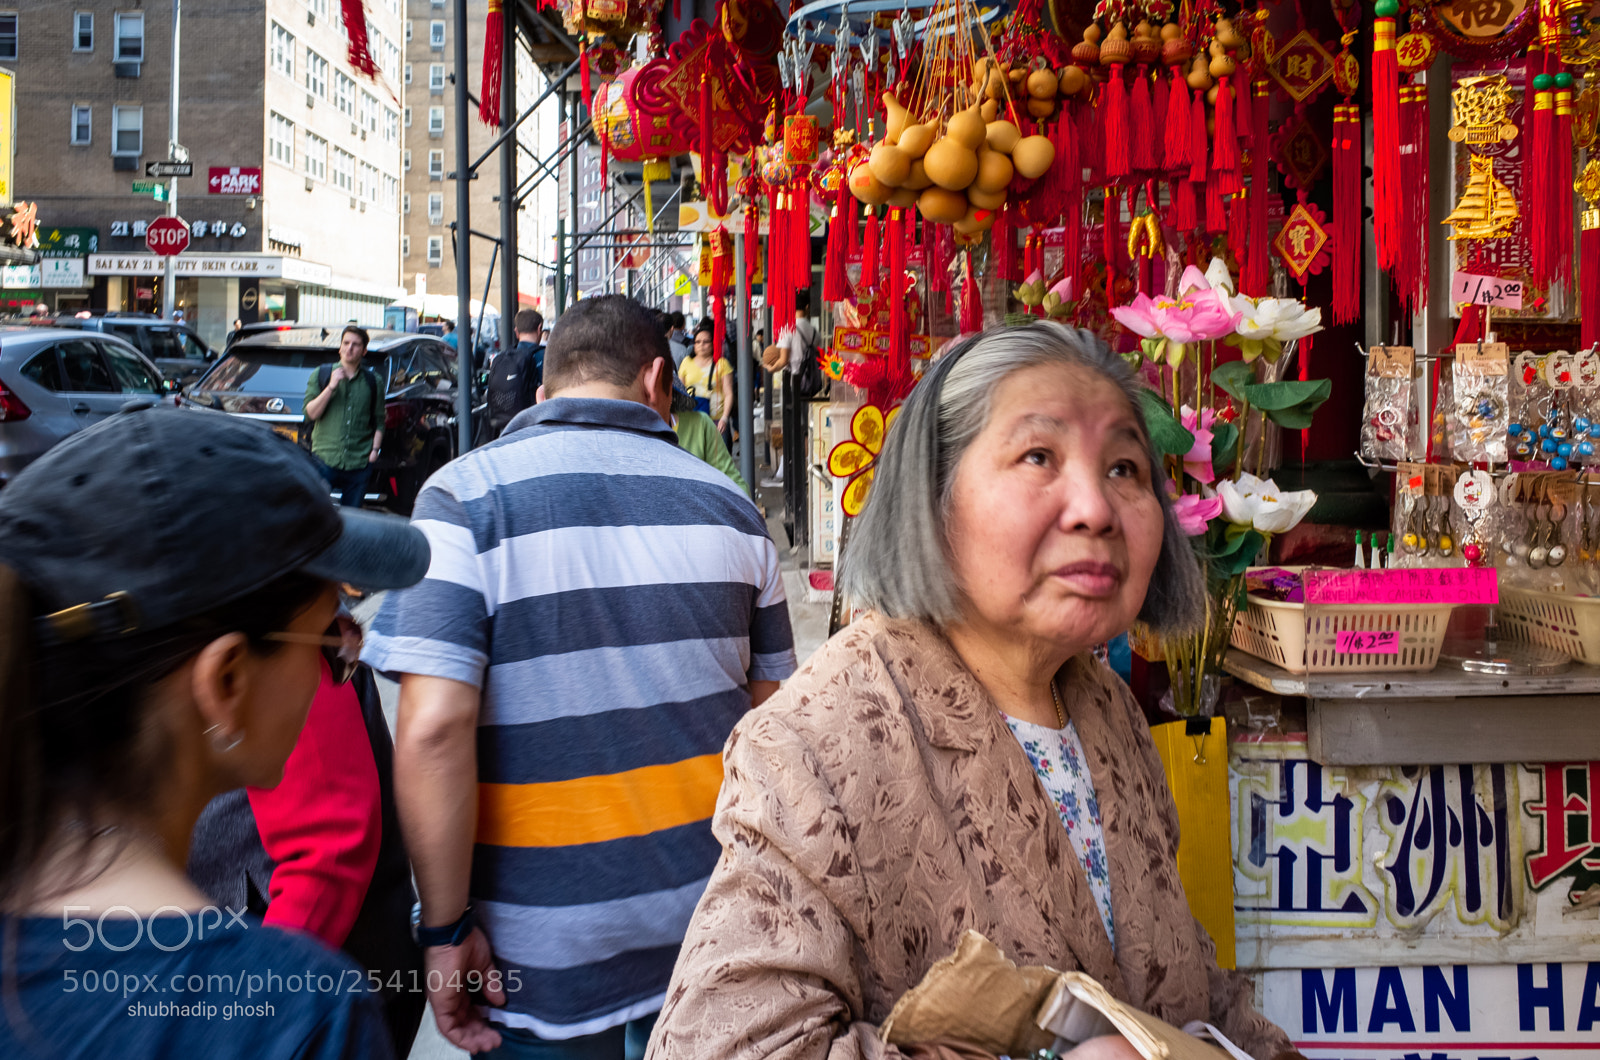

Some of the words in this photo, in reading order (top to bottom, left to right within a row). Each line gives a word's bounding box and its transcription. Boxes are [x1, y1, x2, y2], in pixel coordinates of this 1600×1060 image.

[1286, 53, 1317, 81] 財
[221, 175, 259, 189] PARK
[149, 228, 187, 245] STOP
[615, 239, 648, 257] STOP
[117, 260, 139, 270] KAY
[143, 260, 152, 270] 21
[202, 261, 226, 271] SKIN
[231, 261, 259, 271] CARE
[1388, 589, 1434, 601] CAMERA
[1457, 589, 1481, 600] ON
[1301, 965, 1471, 1034] MAN
